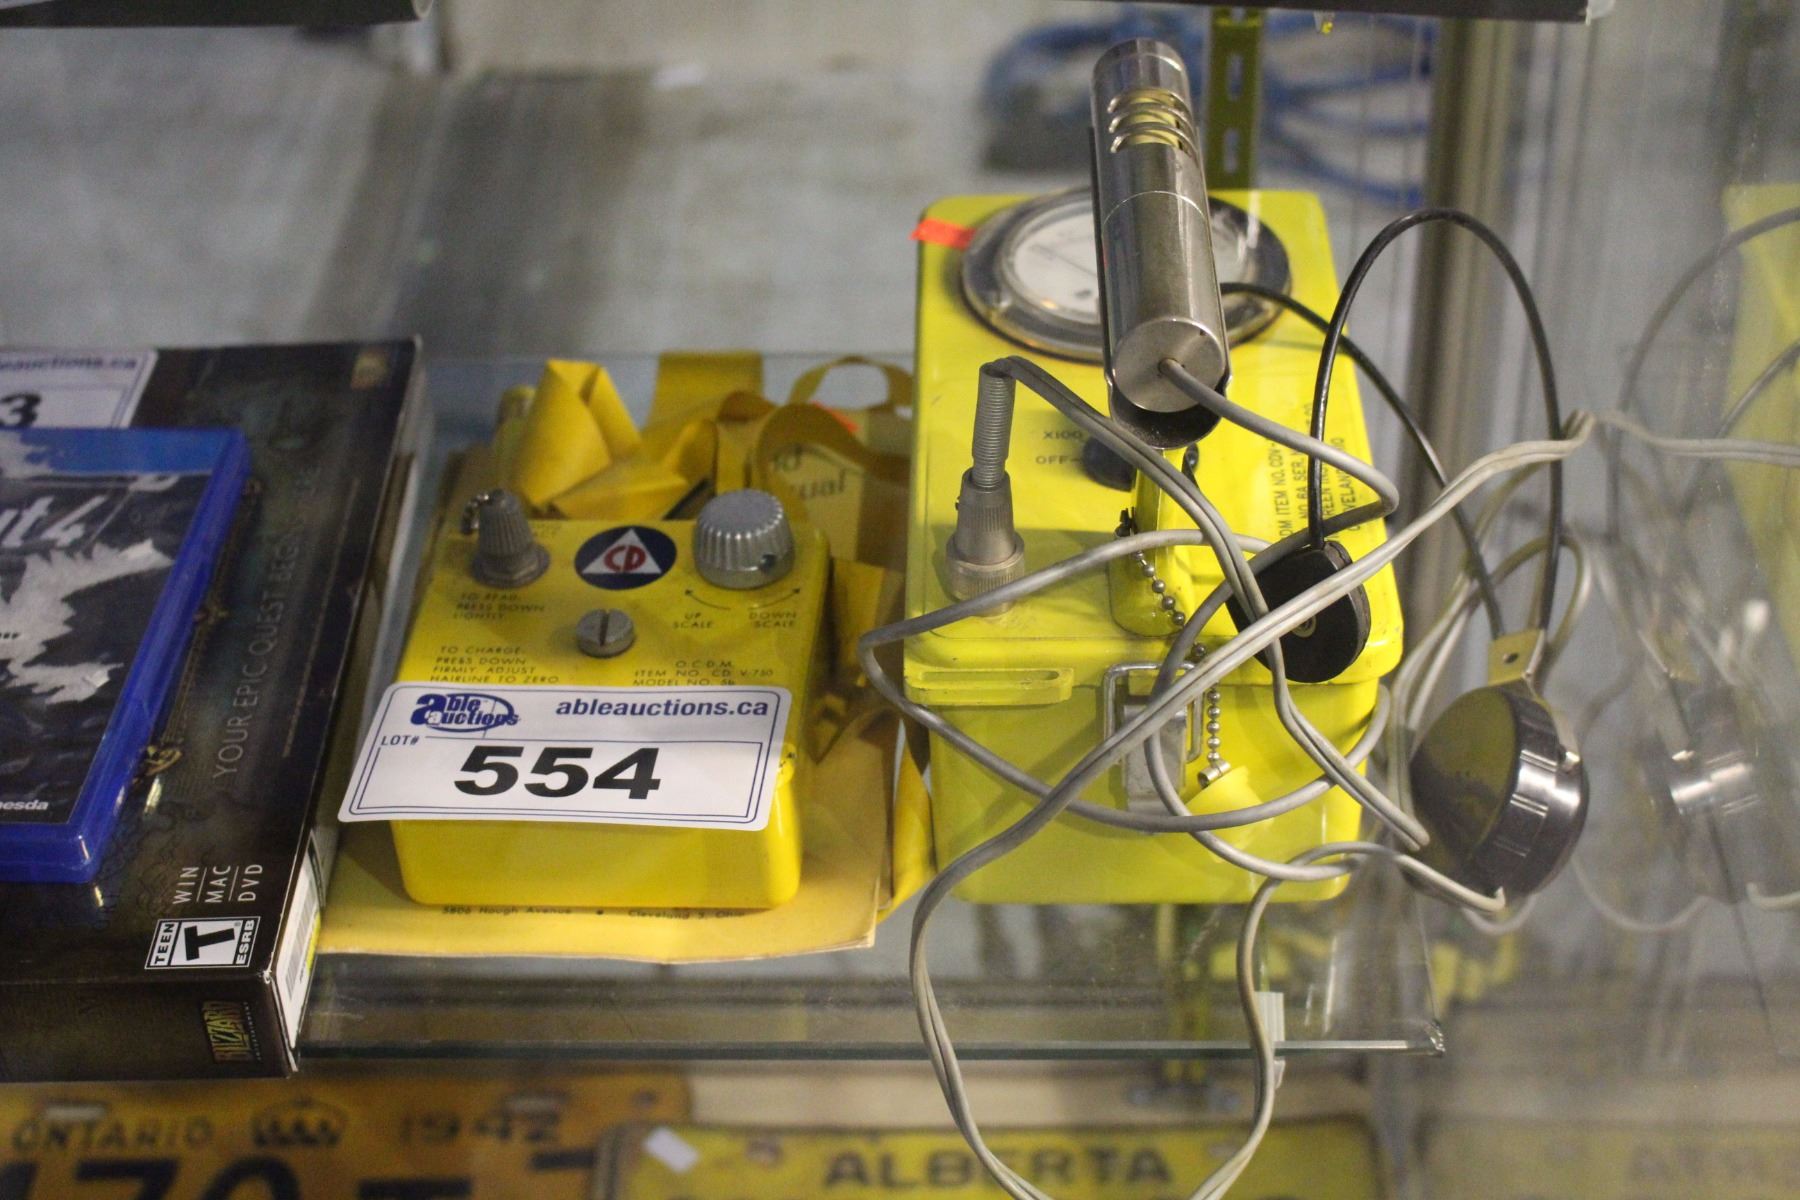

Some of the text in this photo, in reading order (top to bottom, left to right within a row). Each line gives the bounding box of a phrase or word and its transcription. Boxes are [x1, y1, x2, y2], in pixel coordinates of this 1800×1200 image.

[1035, 455, 1069, 464] OFF
[603, 544, 646, 572] CD
[684, 612, 702, 620] UP
[749, 612, 797, 620] DOWN
[673, 621, 713, 629] SCALE
[754, 620, 795, 628] SCALE
[441, 646, 459, 654] TO
[436, 657, 526, 665] PRESS DOWN
[486, 666, 536, 674] ADJUST
[634, 669, 666, 677] ITEM
[430, 675, 560, 684] HAIRLINE TO ZERO
[632, 679, 679, 687] MODEL
[556, 697, 768, 716] ableauctions.ca
[213, 714, 252, 779] YOUR
[233, 664, 267, 708] EPIC
[381, 735, 420, 746] LOT#
[454, 745, 661, 800] 554
[172, 866, 200, 904] WIN
[204, 865, 232, 903] MAC
[237, 864, 263, 902] DVD
[154, 922, 175, 965] TEEN
[184, 925, 235, 961] T
[236, 919, 255, 965] ESRB
